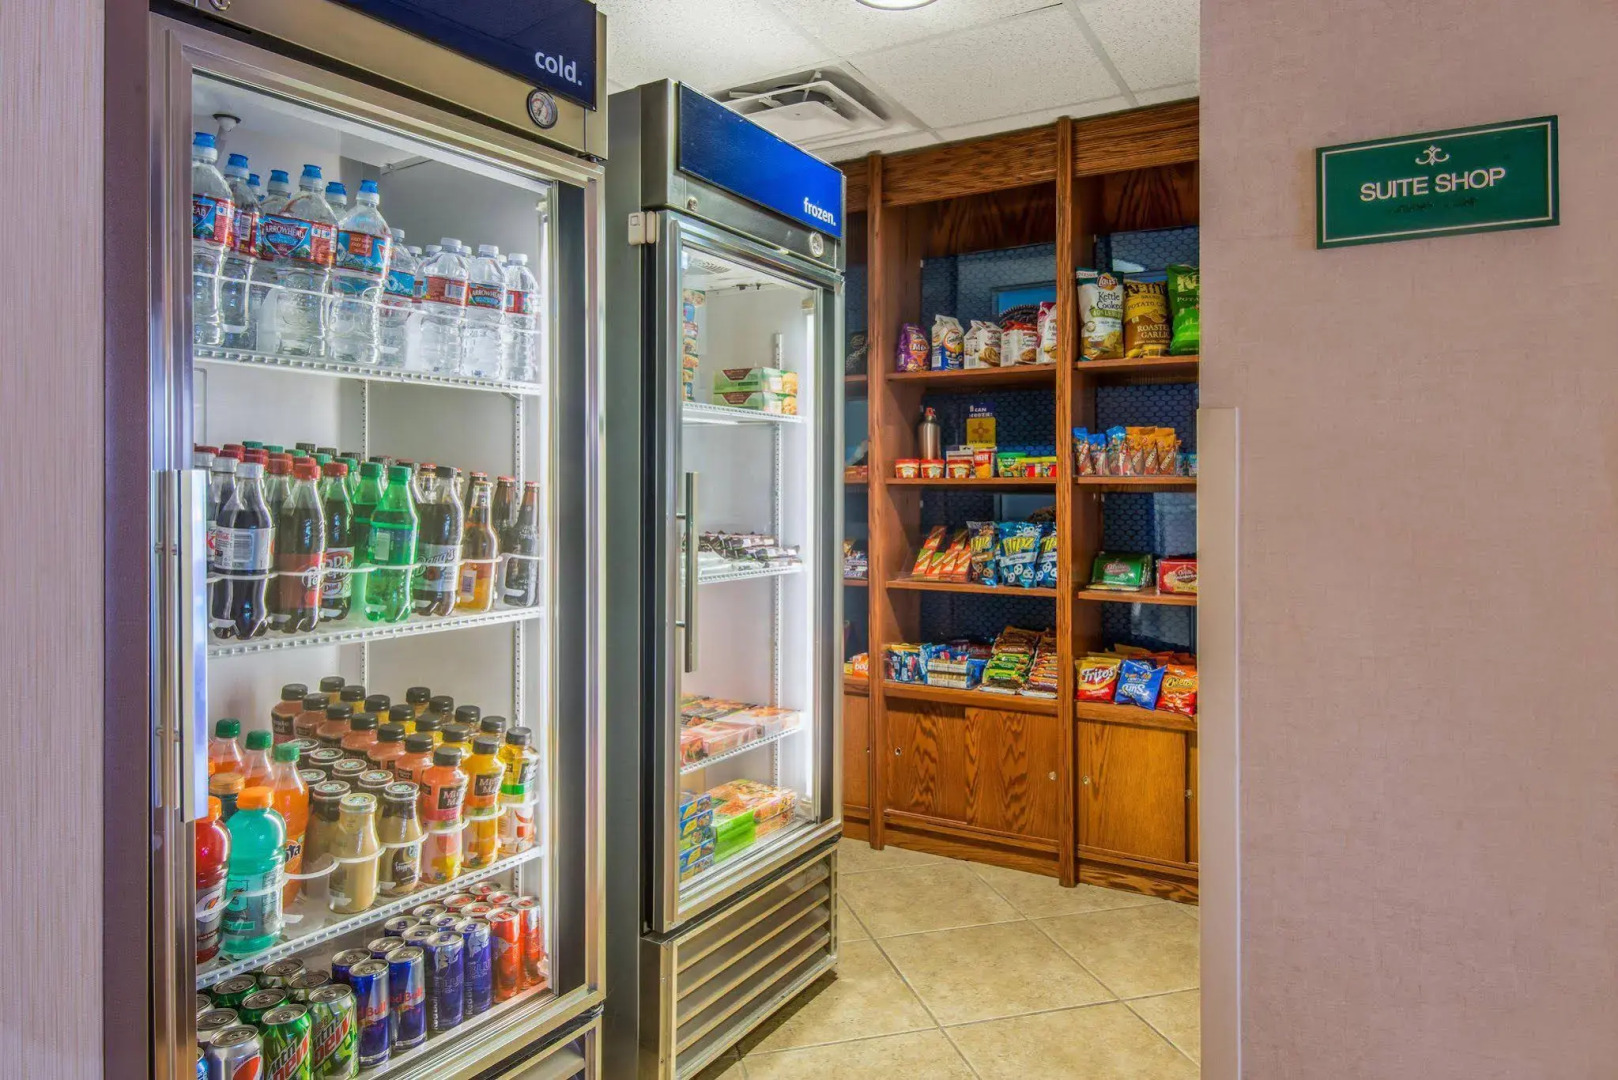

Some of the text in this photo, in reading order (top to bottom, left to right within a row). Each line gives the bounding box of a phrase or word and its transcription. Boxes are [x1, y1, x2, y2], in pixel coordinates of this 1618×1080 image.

[534, 51, 583, 87] cold.
[1360, 167, 1506, 202] SUITE SHOP
[803, 197, 837, 227] frozen.
[265, 224, 304, 239] ARROWHEAD
[1097, 291, 1121, 301] Kettle
[1081, 668, 1115, 683] Fritos
[1166, 677, 1194, 688] Cheetos
